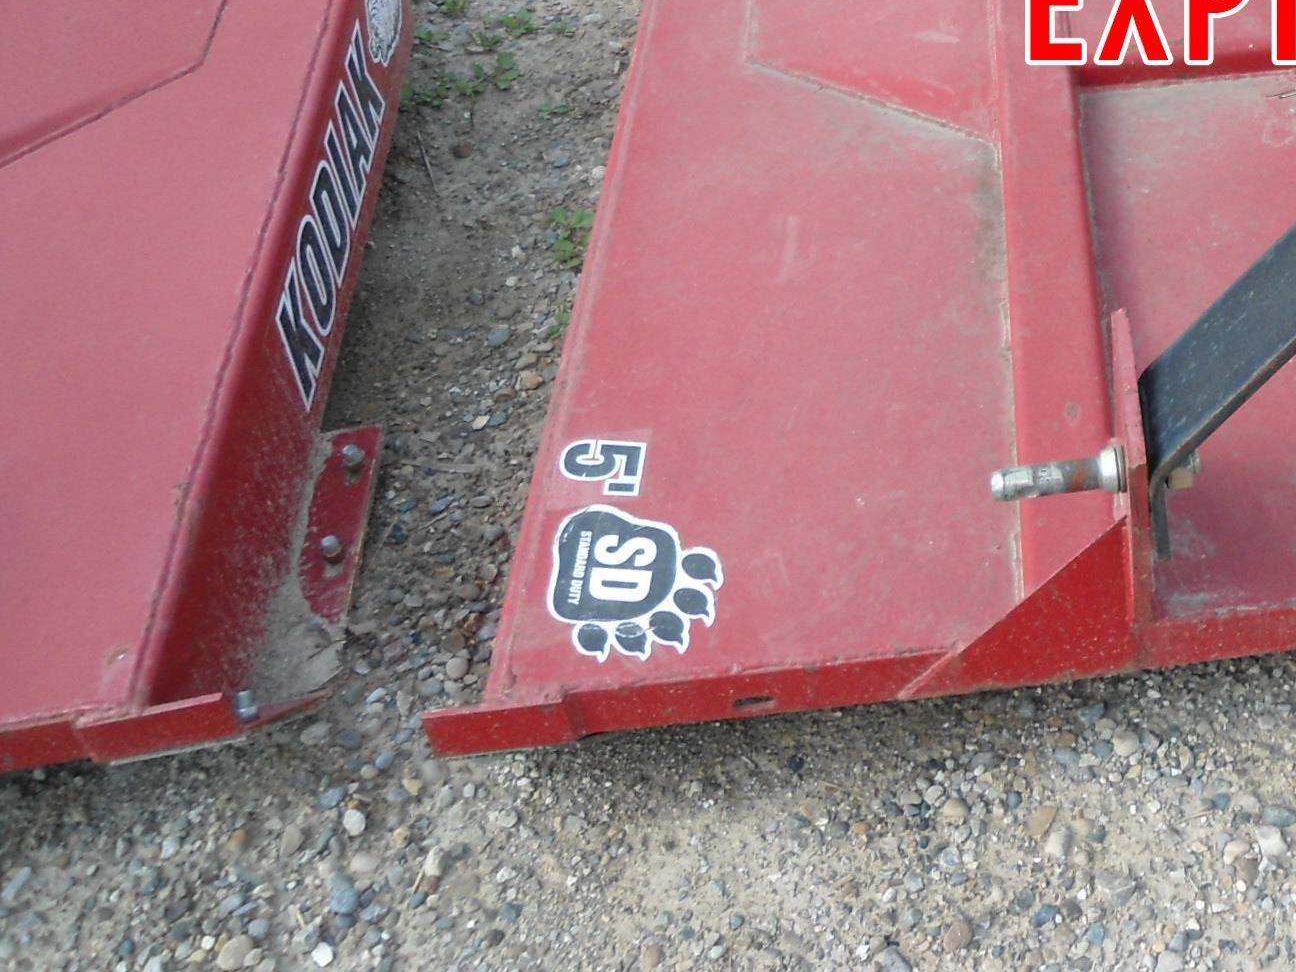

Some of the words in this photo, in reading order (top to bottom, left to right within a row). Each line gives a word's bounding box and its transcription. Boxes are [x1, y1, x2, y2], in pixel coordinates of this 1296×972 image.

[276, 19, 386, 412] KODIAK
[572, 530, 592, 578] STANDARD
[589, 534, 657, 602] SD
[568, 579, 584, 605] DUTY
